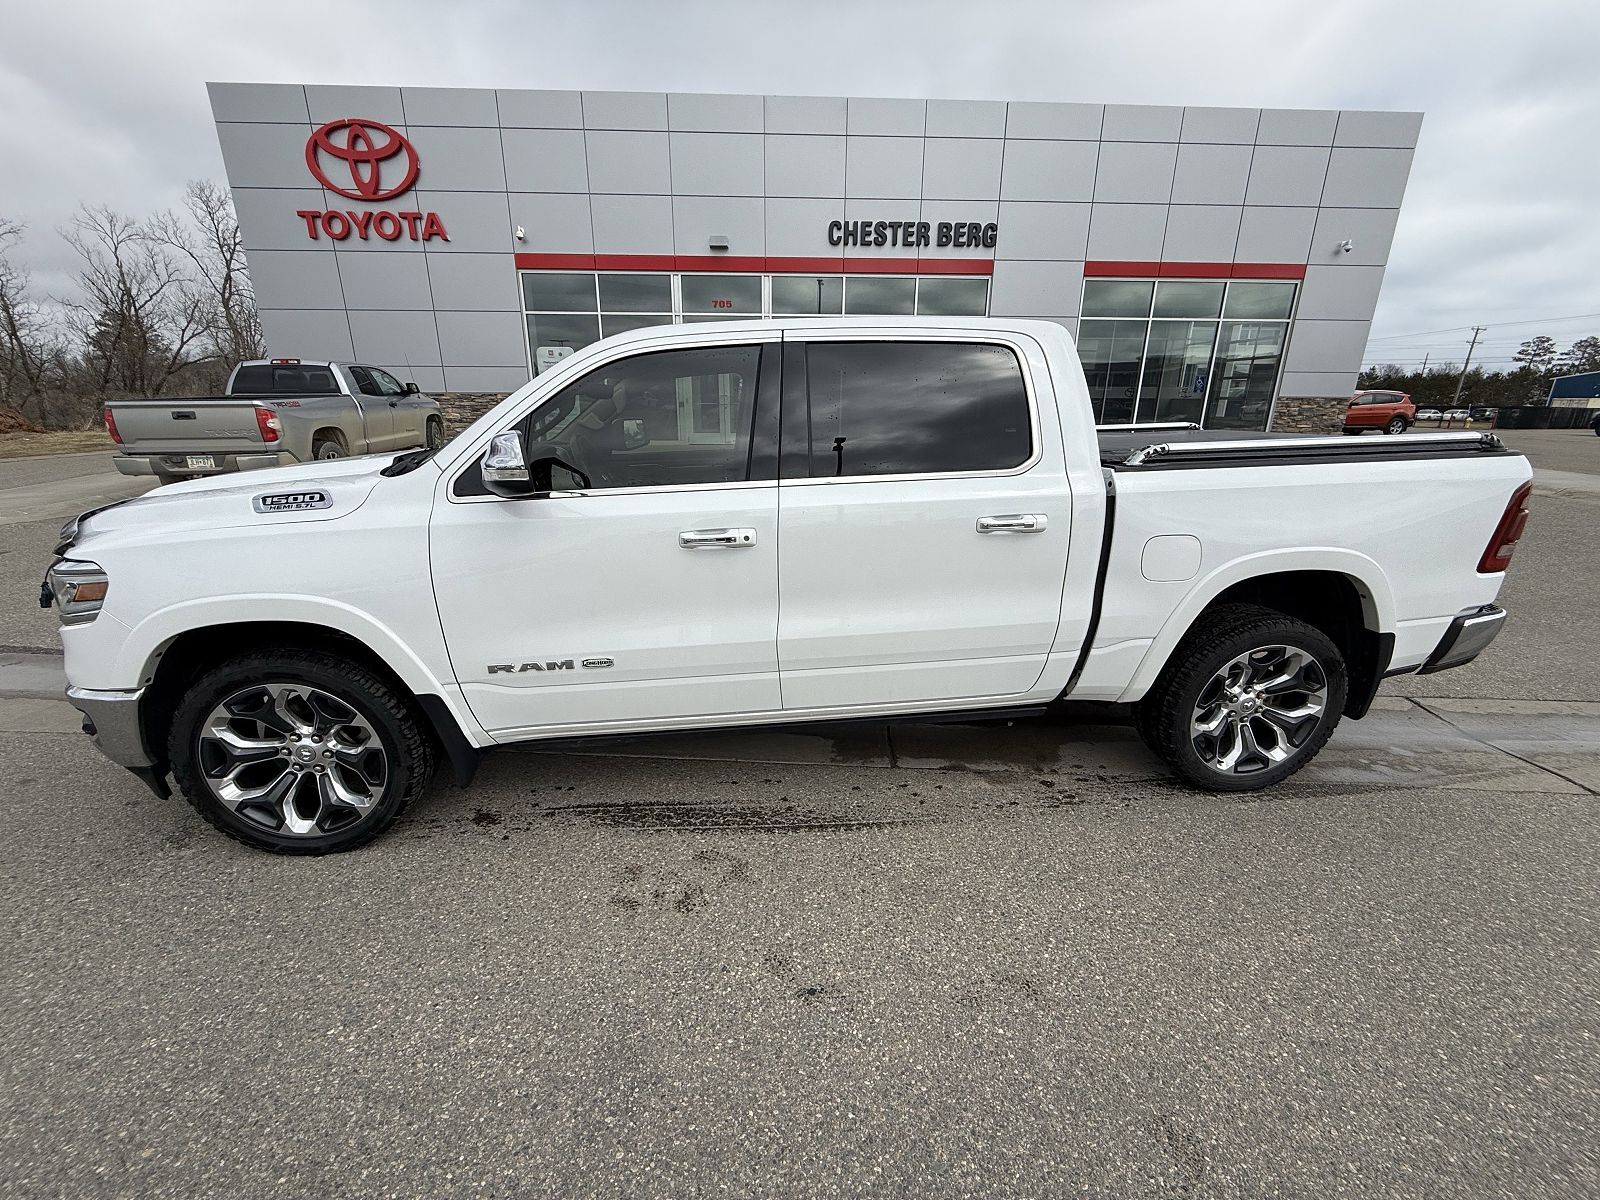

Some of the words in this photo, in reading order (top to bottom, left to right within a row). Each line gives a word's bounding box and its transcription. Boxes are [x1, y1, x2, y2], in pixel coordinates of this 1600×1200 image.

[296, 210, 451, 242] TOYOTA
[828, 220, 931, 247] CHESTER
[936, 222, 998, 248] BERG
[711, 300, 733, 309] 705
[265, 493, 320, 505] 1500
[487, 659, 576, 674] RAM
